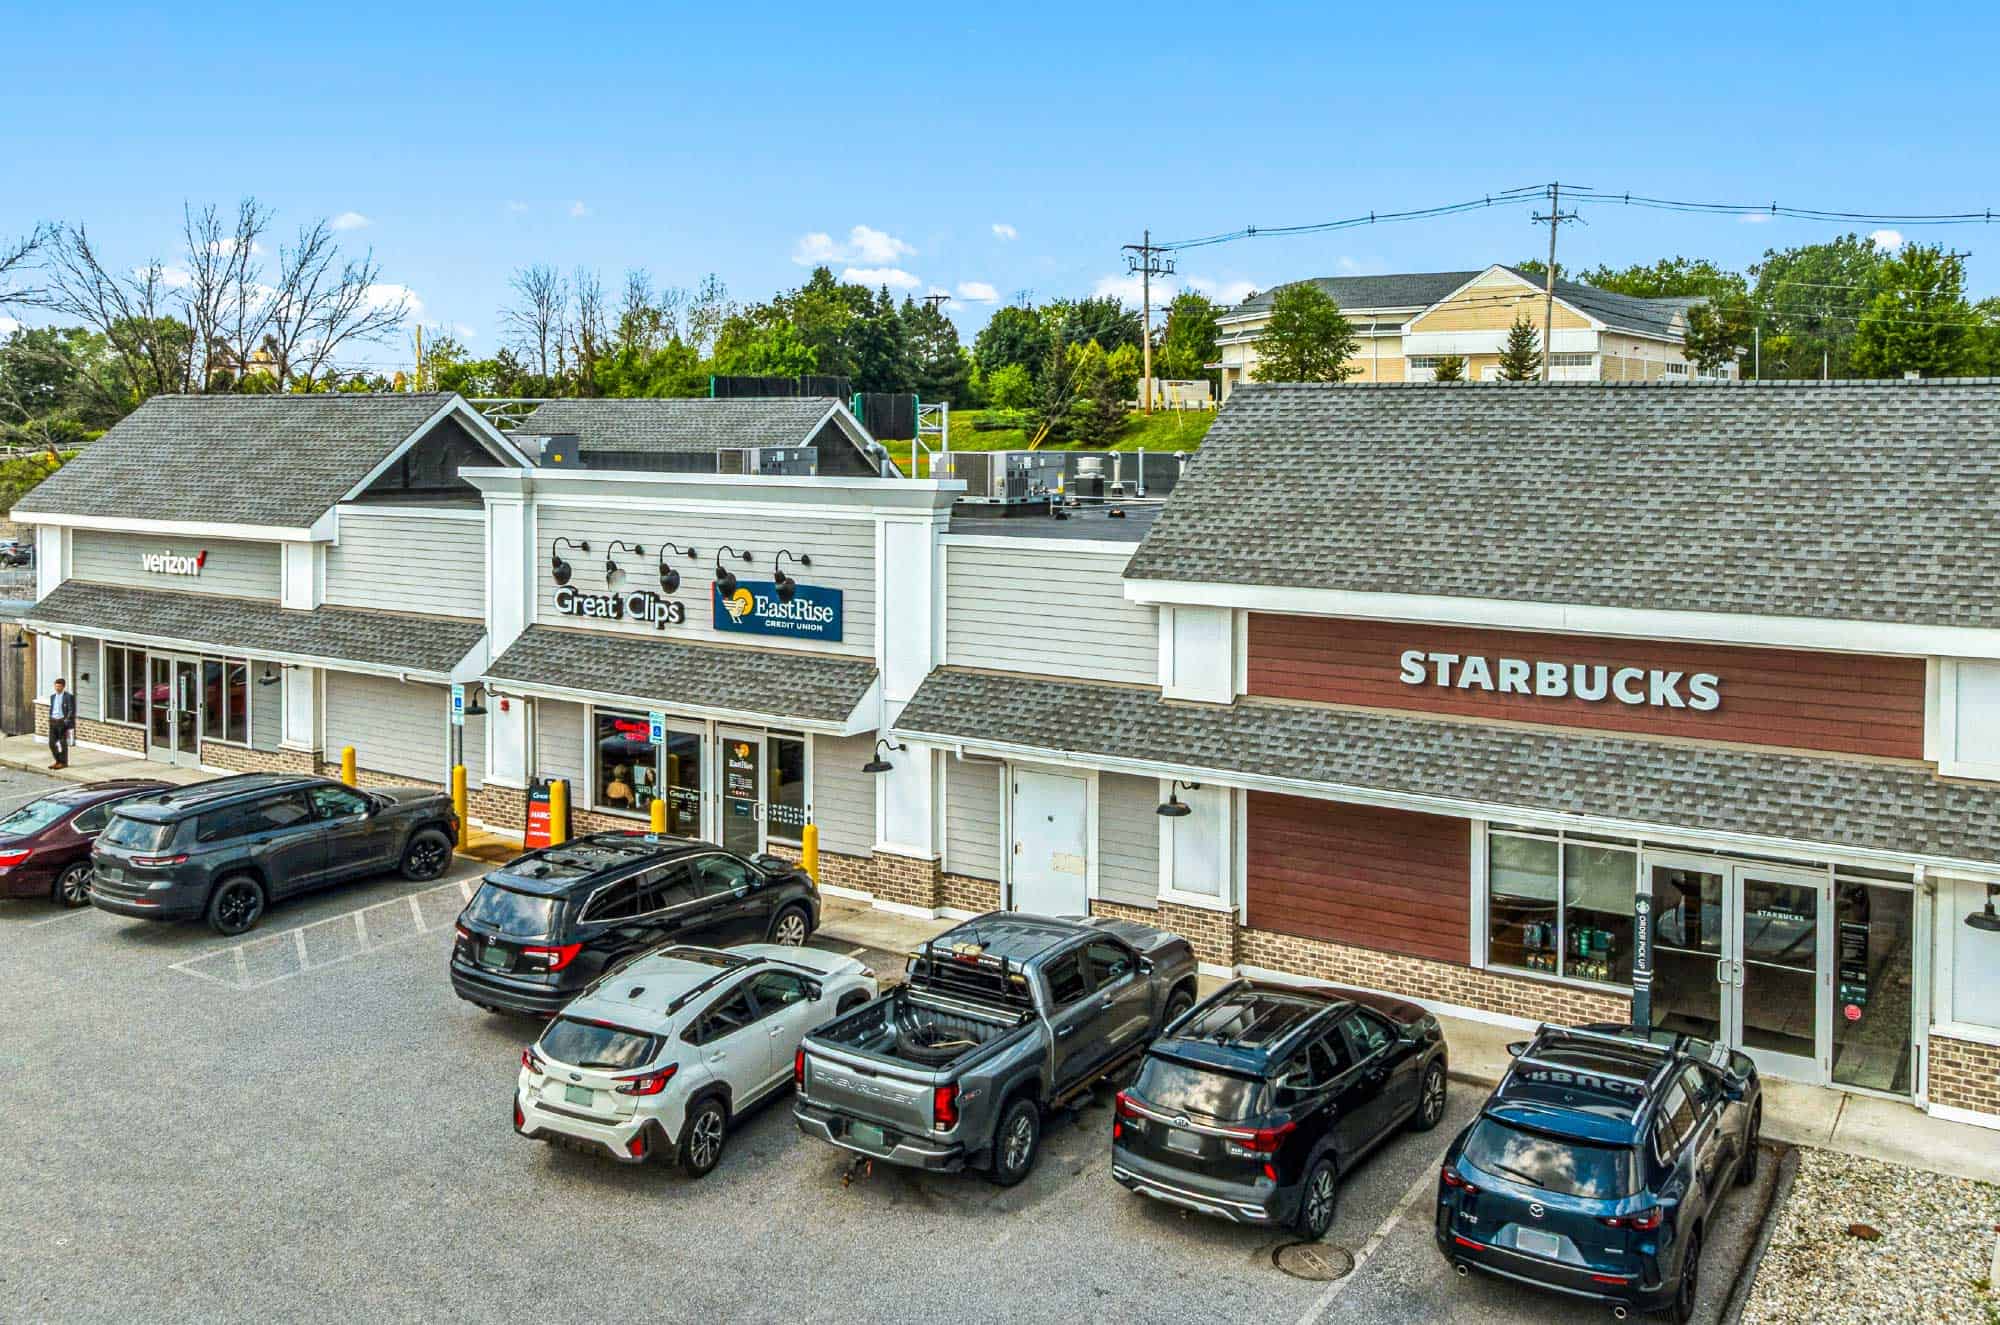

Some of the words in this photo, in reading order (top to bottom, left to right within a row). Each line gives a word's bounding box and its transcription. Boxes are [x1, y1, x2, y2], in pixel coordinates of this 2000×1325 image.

[142, 550, 199, 575] verizon
[554, 587, 618, 618] Great
[626, 592, 680, 630] Clips
[754, 595, 833, 623] EastRise
[765, 620, 795, 631] CREDIT
[796, 622, 823, 633] UNION
[1400, 650, 1720, 711] STARBUCKS
